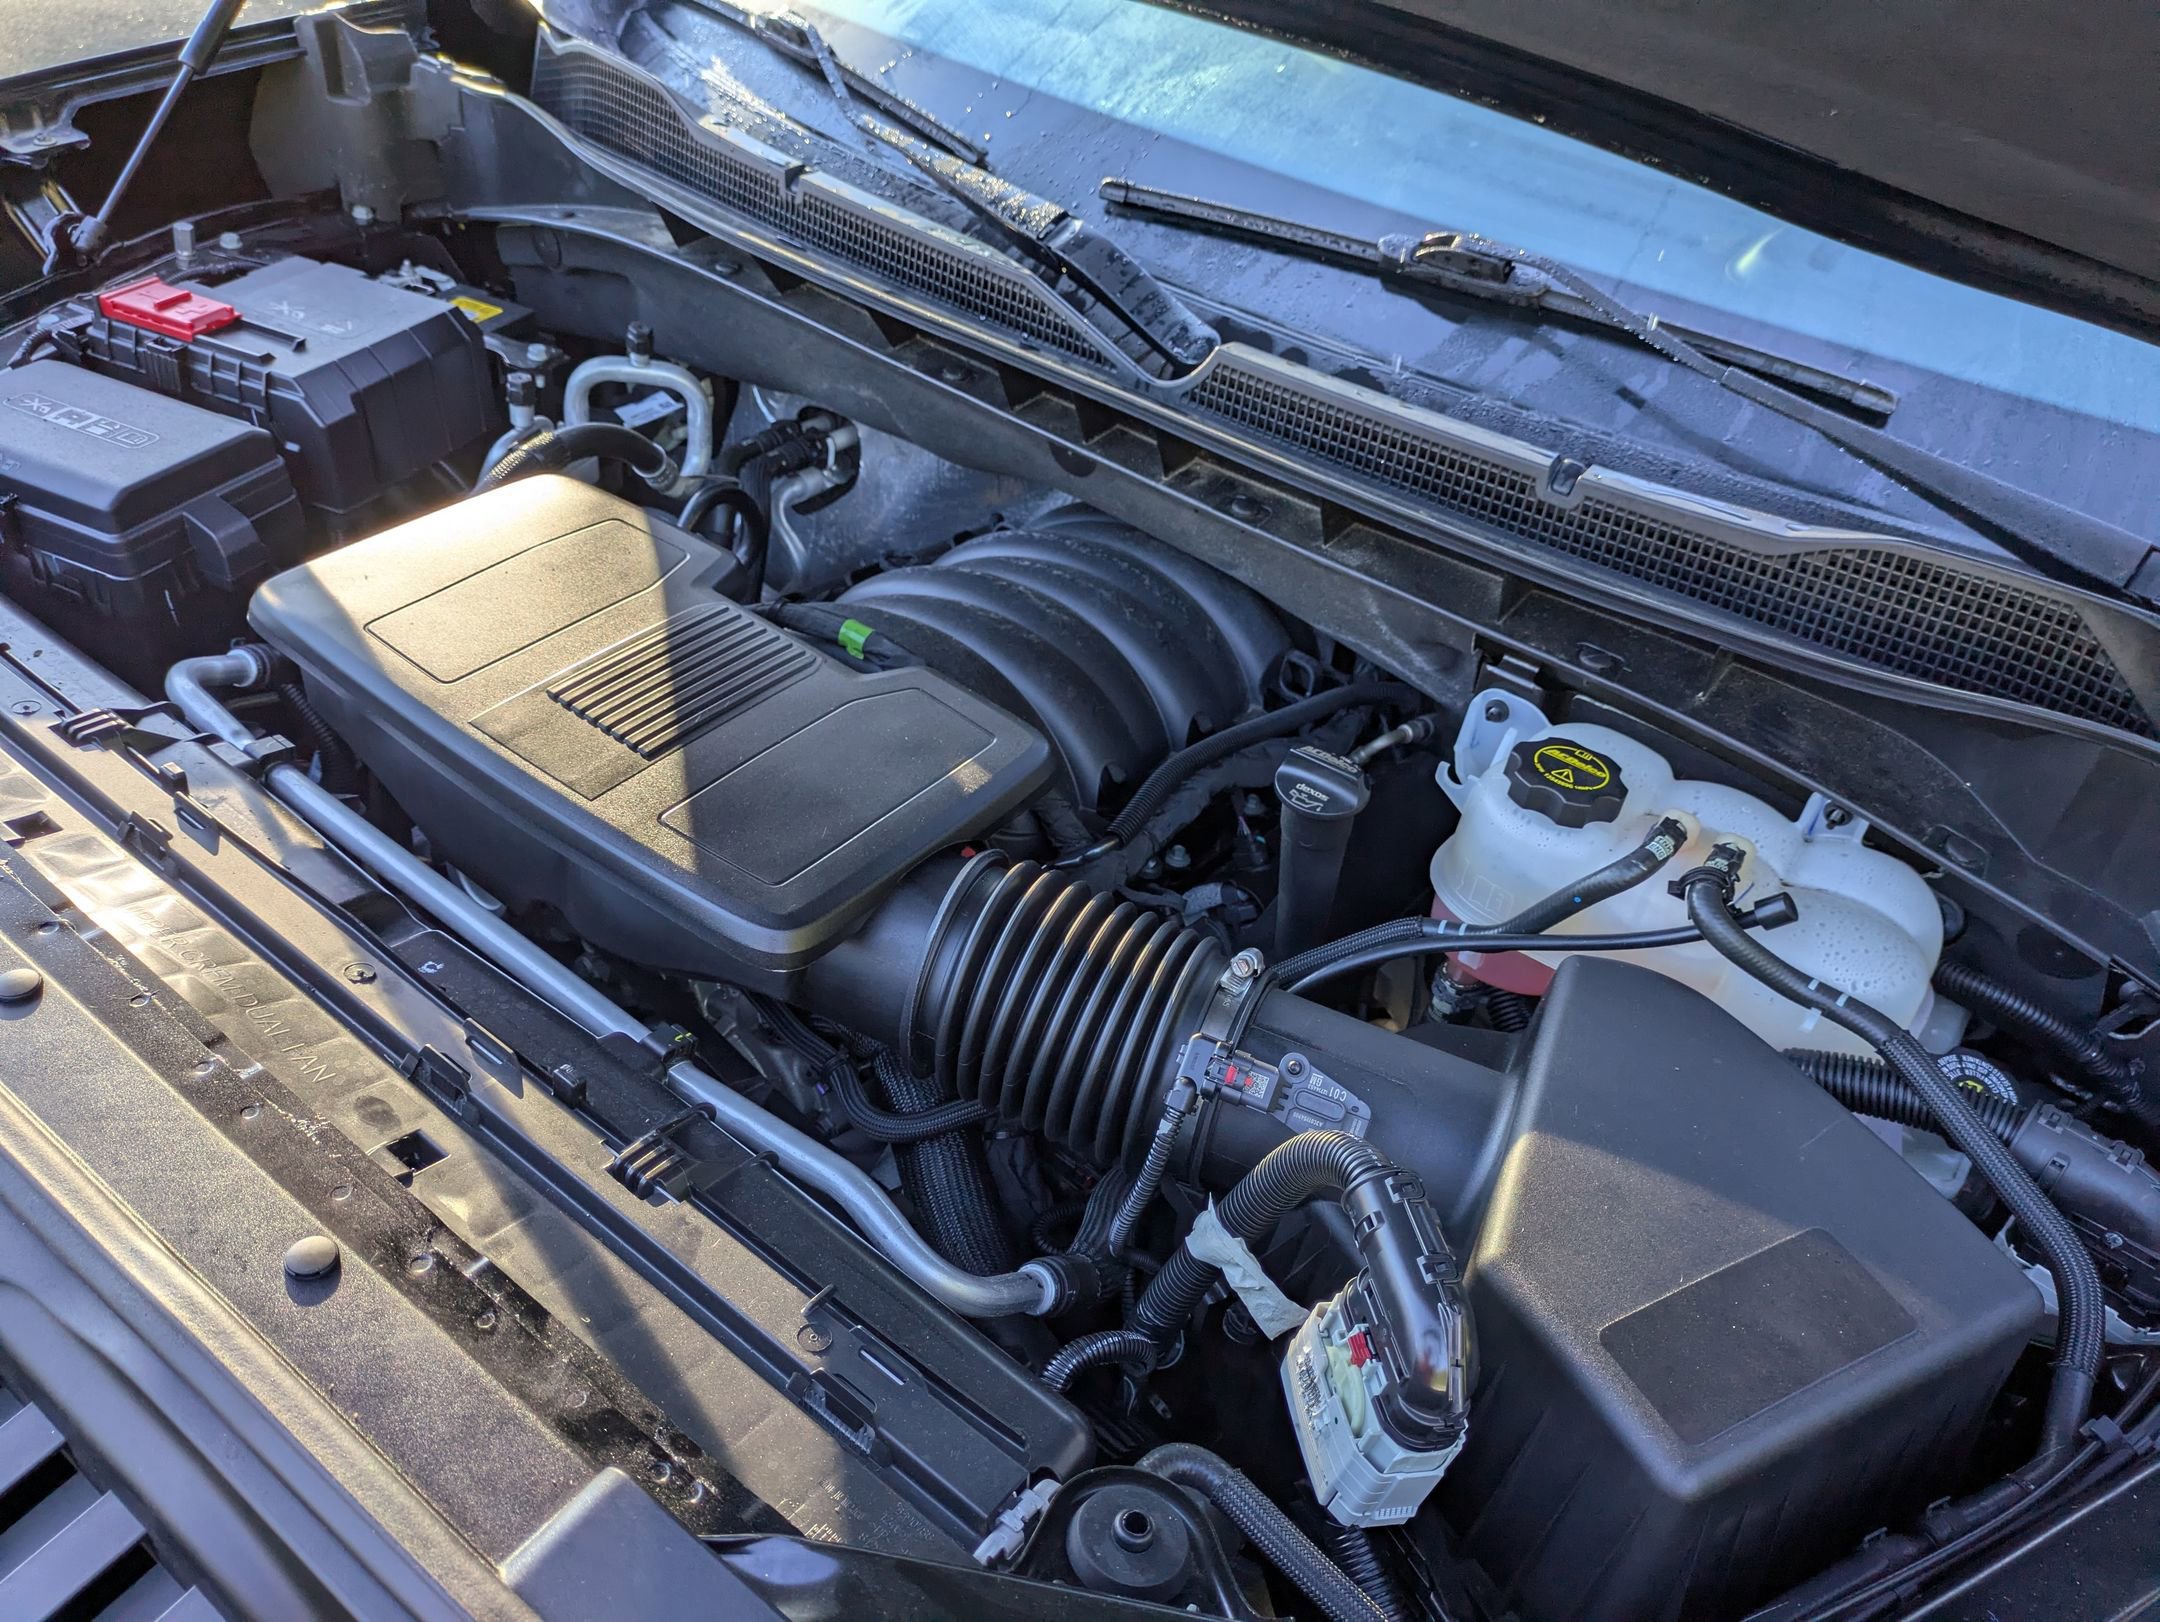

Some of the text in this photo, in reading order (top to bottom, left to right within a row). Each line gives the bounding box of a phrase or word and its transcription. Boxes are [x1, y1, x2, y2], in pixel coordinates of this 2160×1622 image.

[1295, 783, 1330, 802] dexos
[232, 992, 290, 1043] DUAL
[1309, 1073, 1324, 1086] GM
[1328, 1086, 1347, 1102] C01
